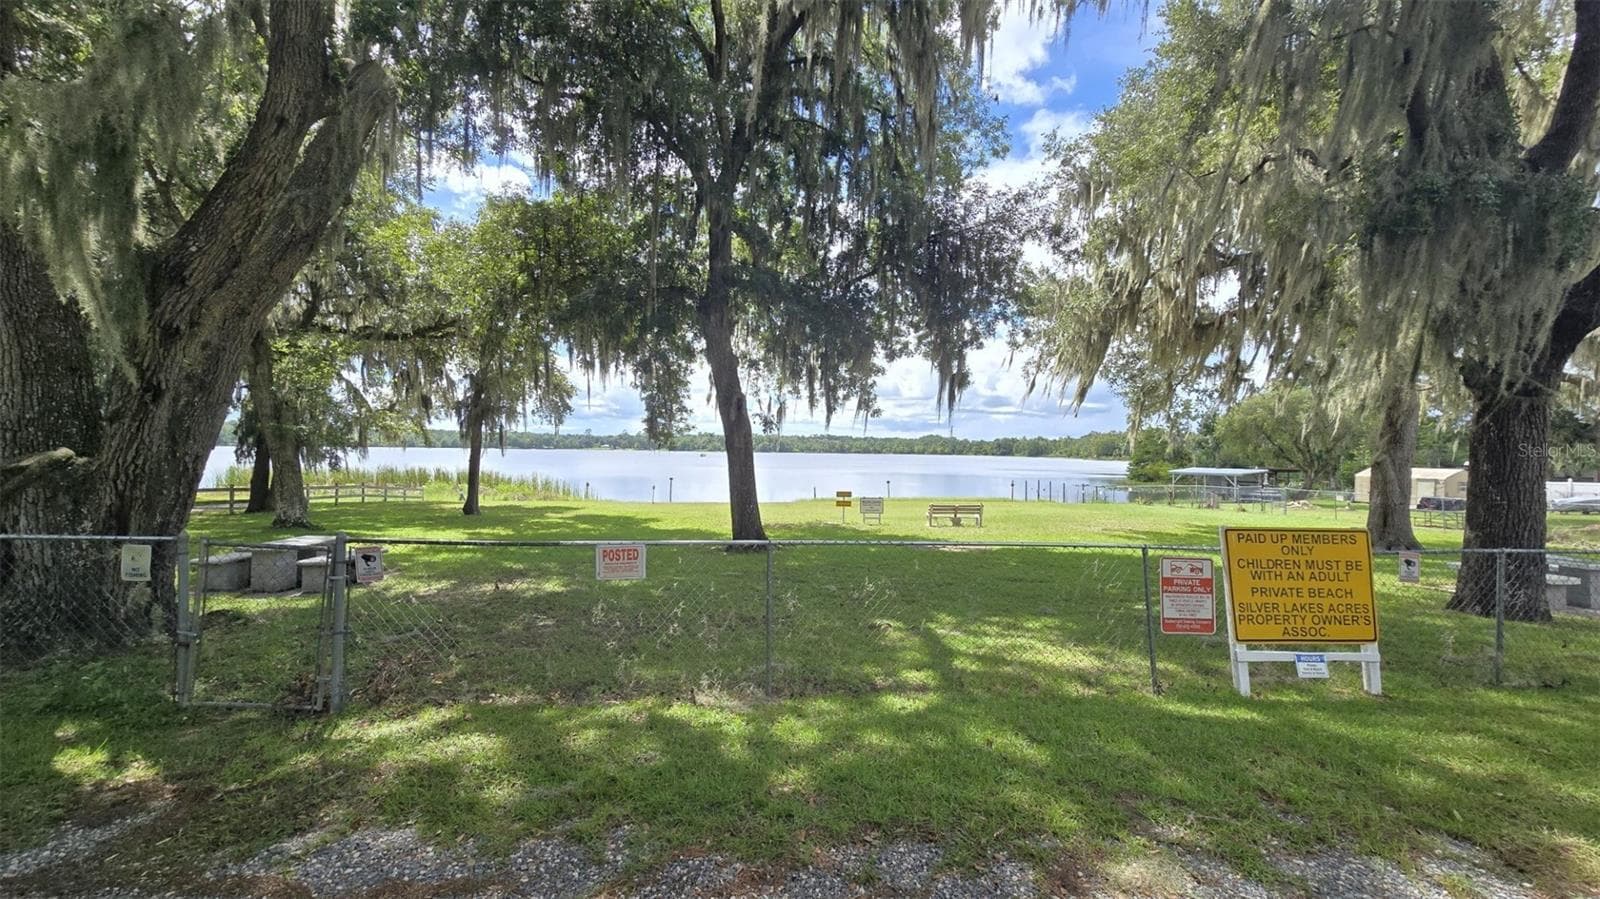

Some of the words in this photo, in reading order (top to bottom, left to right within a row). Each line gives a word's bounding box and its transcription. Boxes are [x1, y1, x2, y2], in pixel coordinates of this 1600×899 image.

[1237, 533, 1267, 544] PAID
[1270, 533, 1288, 545] UP
[1292, 534, 1358, 545] MEMBERS
[602, 548, 639, 561] POSTED
[1281, 545, 1315, 556] ONLY
[1237, 558, 1301, 570] CHILDREN
[1305, 559, 1342, 571] MUST
[1345, 560, 1363, 571] BE
[1250, 570, 1283, 581] WITH
[1287, 571, 1305, 581] AN
[1309, 571, 1351, 582] ADULT
[1251, 587, 1304, 598] PRIVATE
[1308, 587, 1354, 599] BEACH
[1238, 602, 1280, 614] SILVER
[1284, 602, 1324, 614] LAKES
[1327, 603, 1370, 614] ACRES
[1238, 614, 1307, 625] PROPERTY
[1311, 615, 1371, 626] OWNER'S
[1282, 626, 1331, 638] ASSOC.
